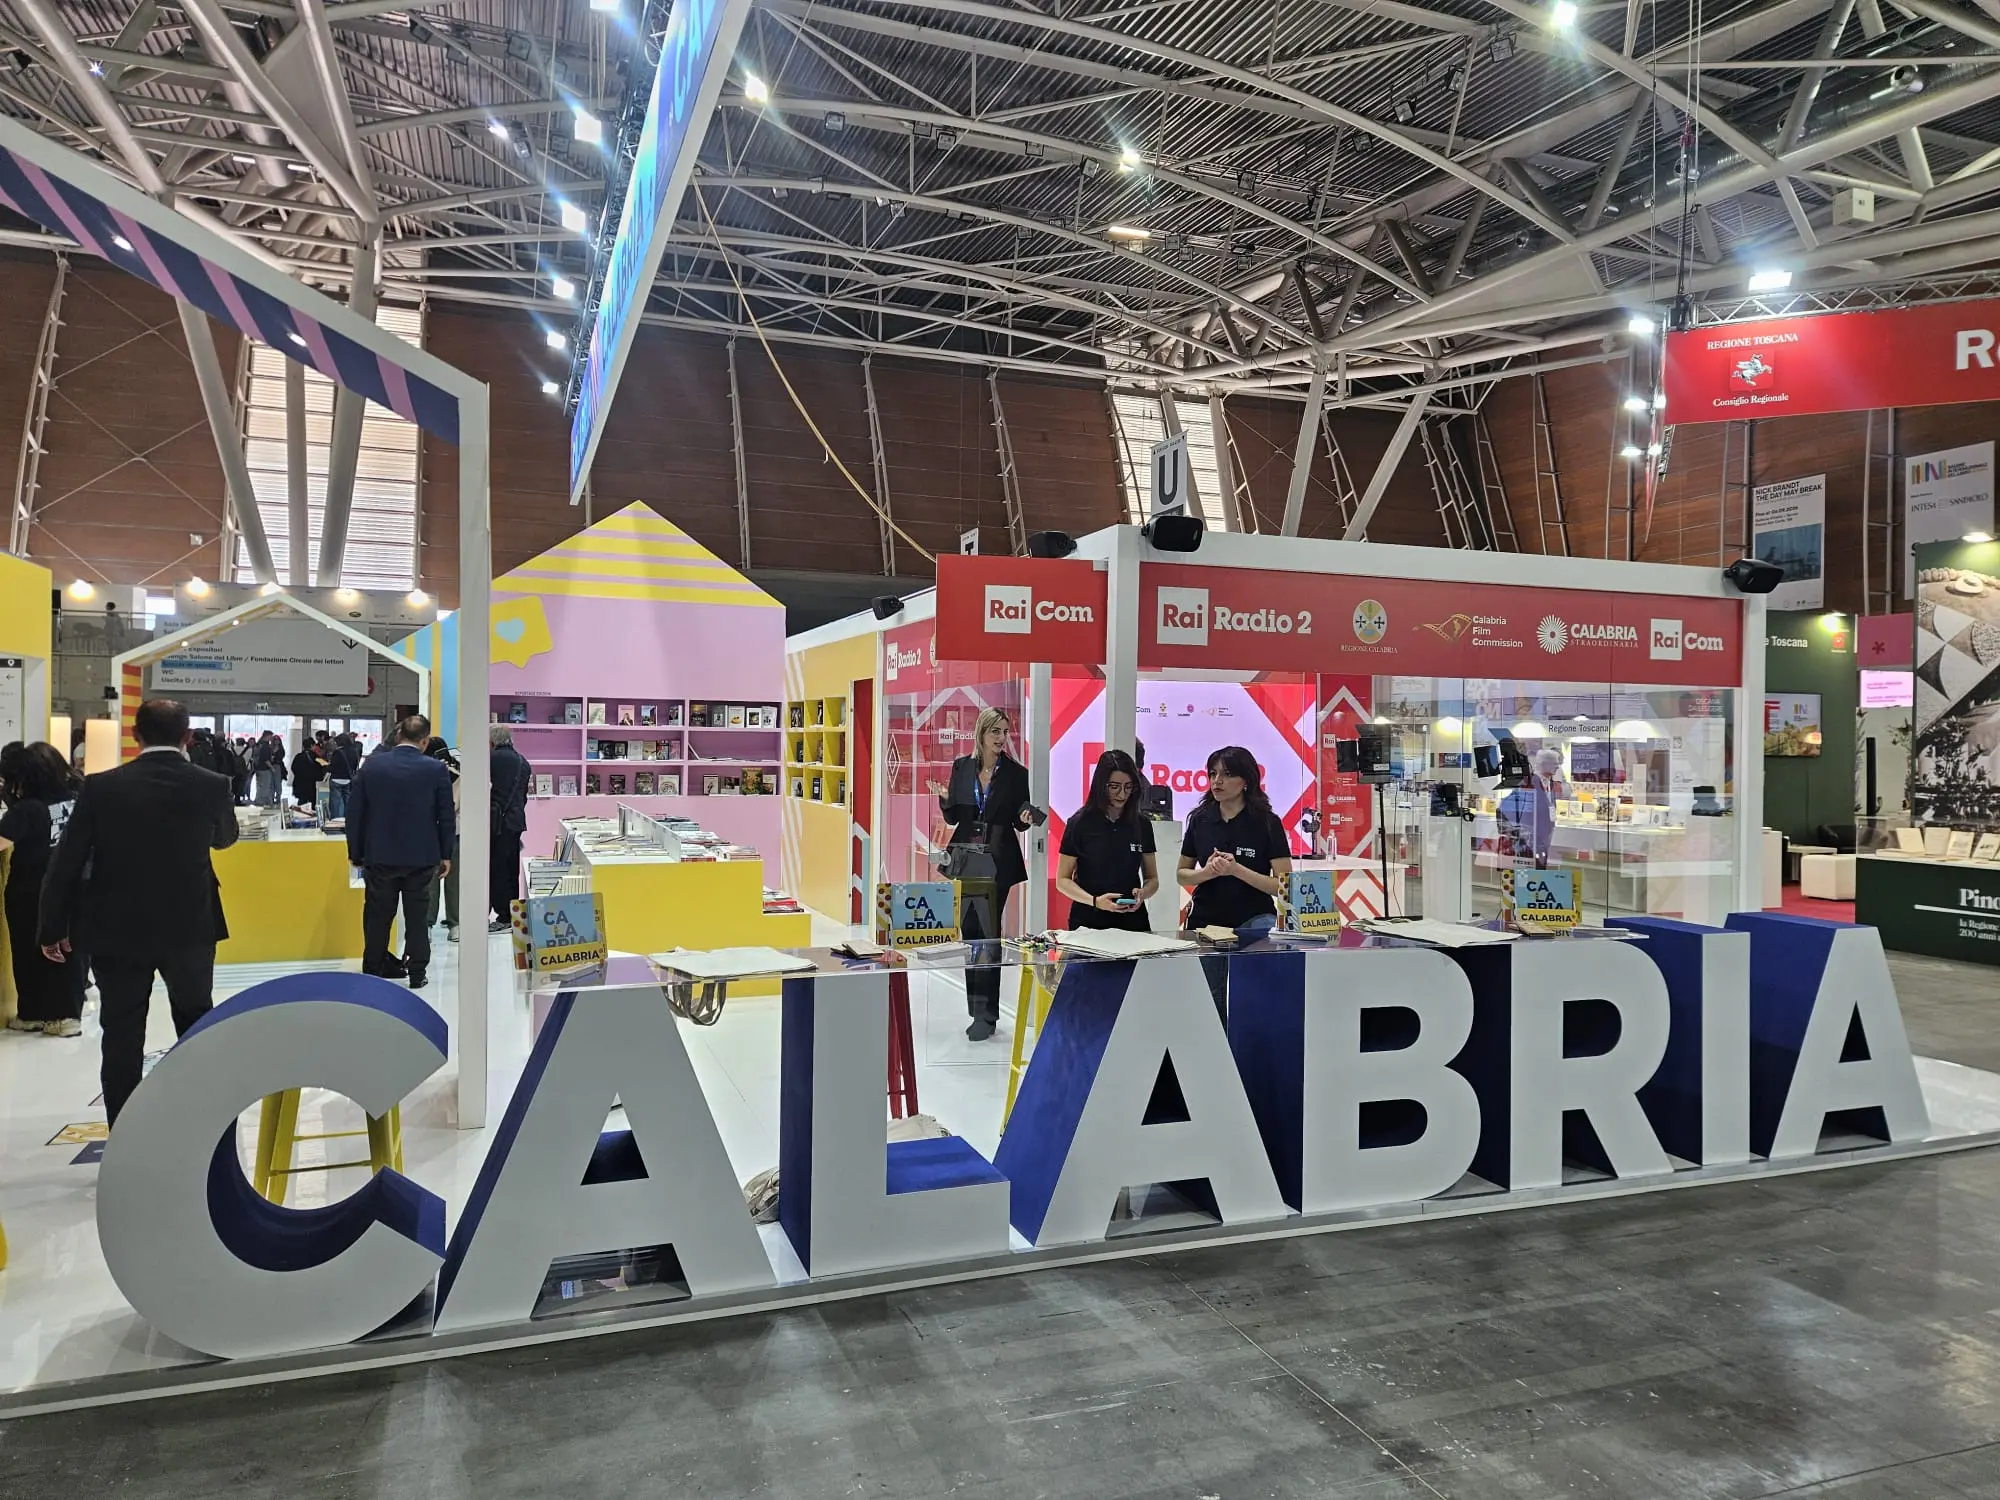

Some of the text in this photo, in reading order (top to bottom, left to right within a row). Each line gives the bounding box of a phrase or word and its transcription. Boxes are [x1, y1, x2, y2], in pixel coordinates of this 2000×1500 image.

[1706, 333, 1798, 350] REGIONE TOSCANA
[1956, 329, 2000, 370] R
[1712, 393, 1789, 407] Consiglio Regionale
[1158, 448, 1178, 506] U
[1756, 481, 1800, 495] NICK BRANDT
[1756, 494, 1768, 502] THE
[1770, 492, 1783, 500] DAY
[1784, 488, 1798, 496] MAY
[1800, 484, 1822, 494] BREAK
[989, 599, 1094, 623] Rai Com
[1162, 603, 1312, 634] Rai Radio 2
[1472, 616, 1507, 625] Calabria
[1472, 626, 1491, 635] Film
[1570, 624, 1638, 640] CALABRIA
[1472, 638, 1523, 648] Commission
[1570, 639, 1639, 648] STRAORDINARIA
[1654, 632, 1724, 651] Rai Com
[1772, 636, 1808, 648] Toscana
[1340, 644, 1398, 654] REGIONE CALABRIA
[940, 732, 952, 740] Rai
[1549, 724, 1609, 734] Regione Toscana
[1300, 884, 1316, 895] CA
[1526, 881, 1549, 892] CA
[904, 896, 929, 910] CA
[543, 910, 569, 926] CA
[1302, 919, 1338, 928] CALABRIA
[1521, 914, 1572, 922] CALABRIA
[896, 934, 952, 945] CALABRIA
[540, 950, 600, 966] CALABRIA
[97, 920, 1931, 1359] CALABRIA
